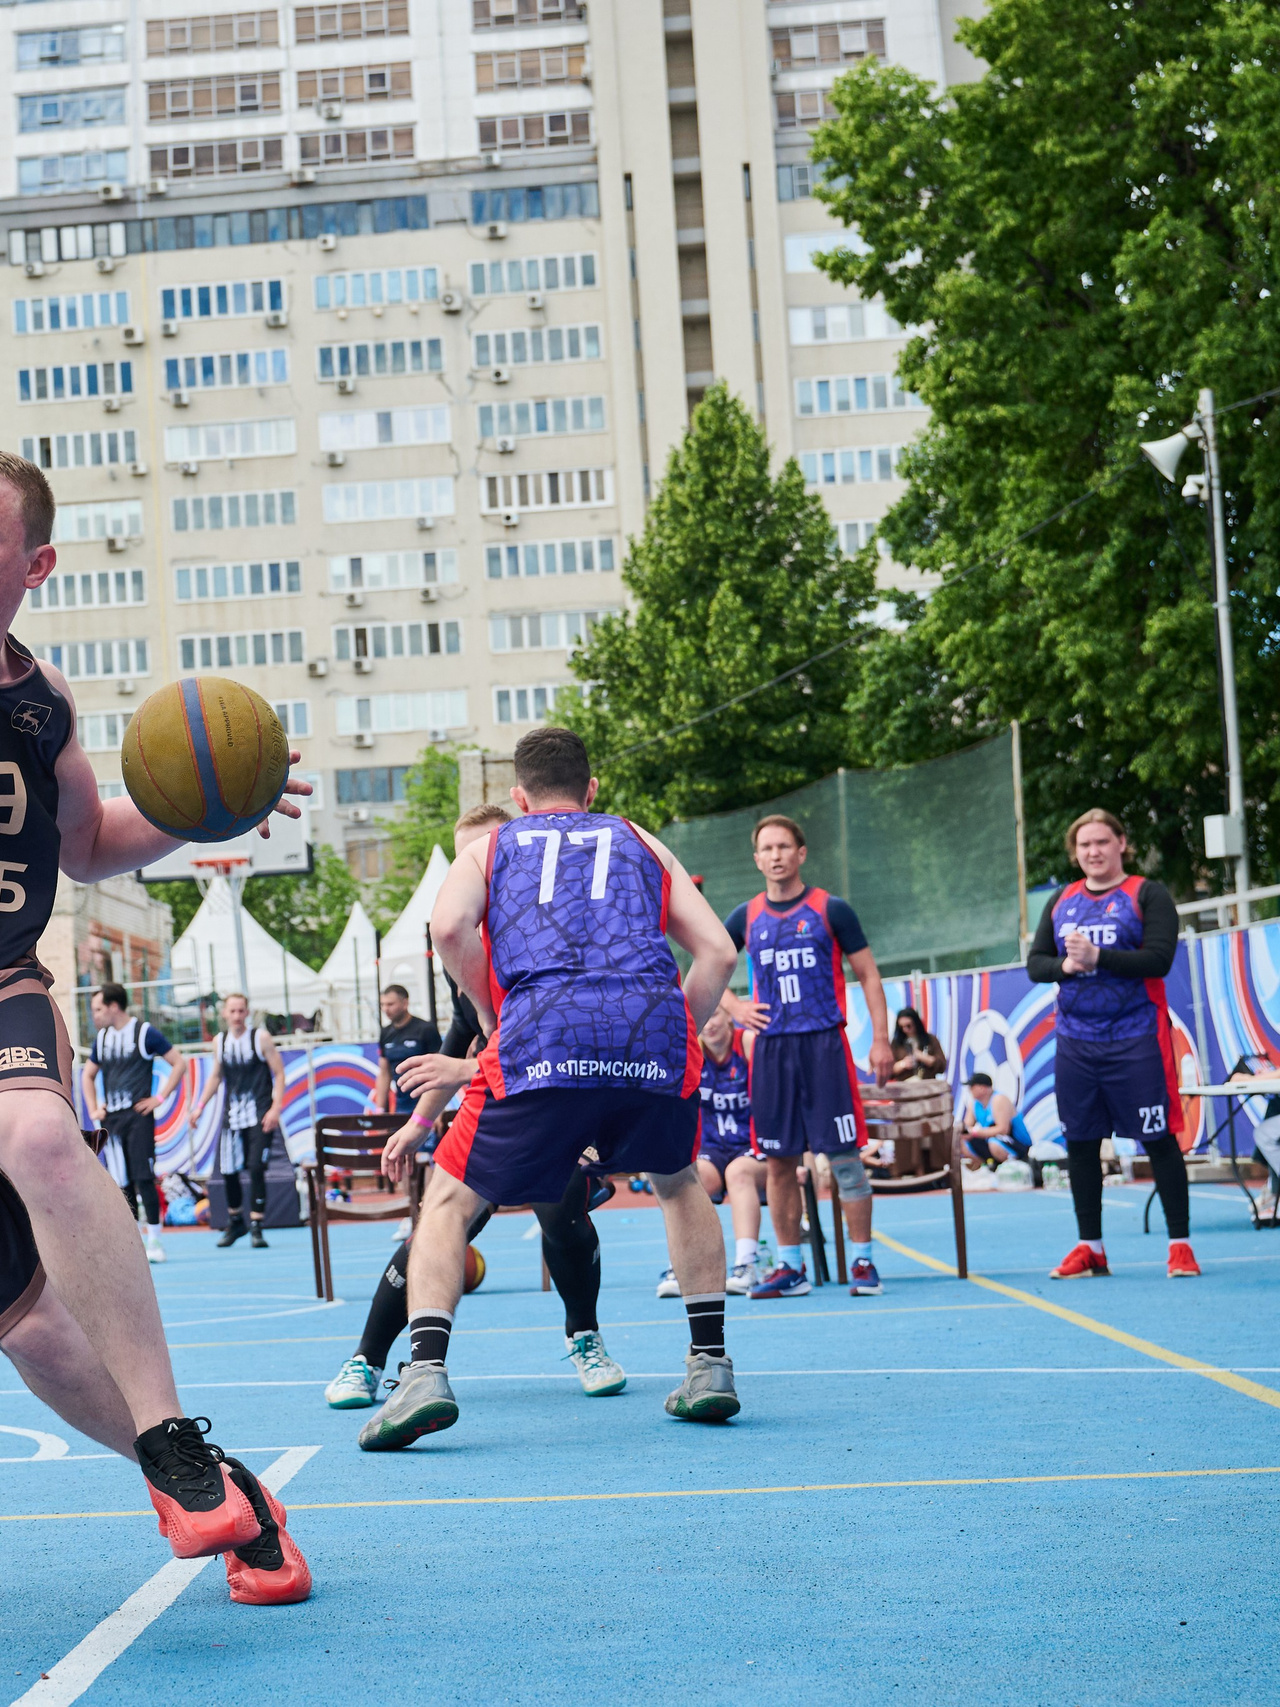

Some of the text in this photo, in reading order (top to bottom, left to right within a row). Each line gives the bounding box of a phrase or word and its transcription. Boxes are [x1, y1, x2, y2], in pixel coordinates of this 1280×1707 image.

[516, 827, 612, 905] 77
[775, 947, 817, 972] ВТБ
[777, 974, 801, 1005] 10
[526, 1060, 667, 1081] РОО «ПЕРМСКИЙ»
[713, 1091, 751, 1111] ВТБ
[715, 1112, 738, 1136] 14
[833, 1113, 857, 1144] 10
[1138, 1105, 1166, 1134] 23
